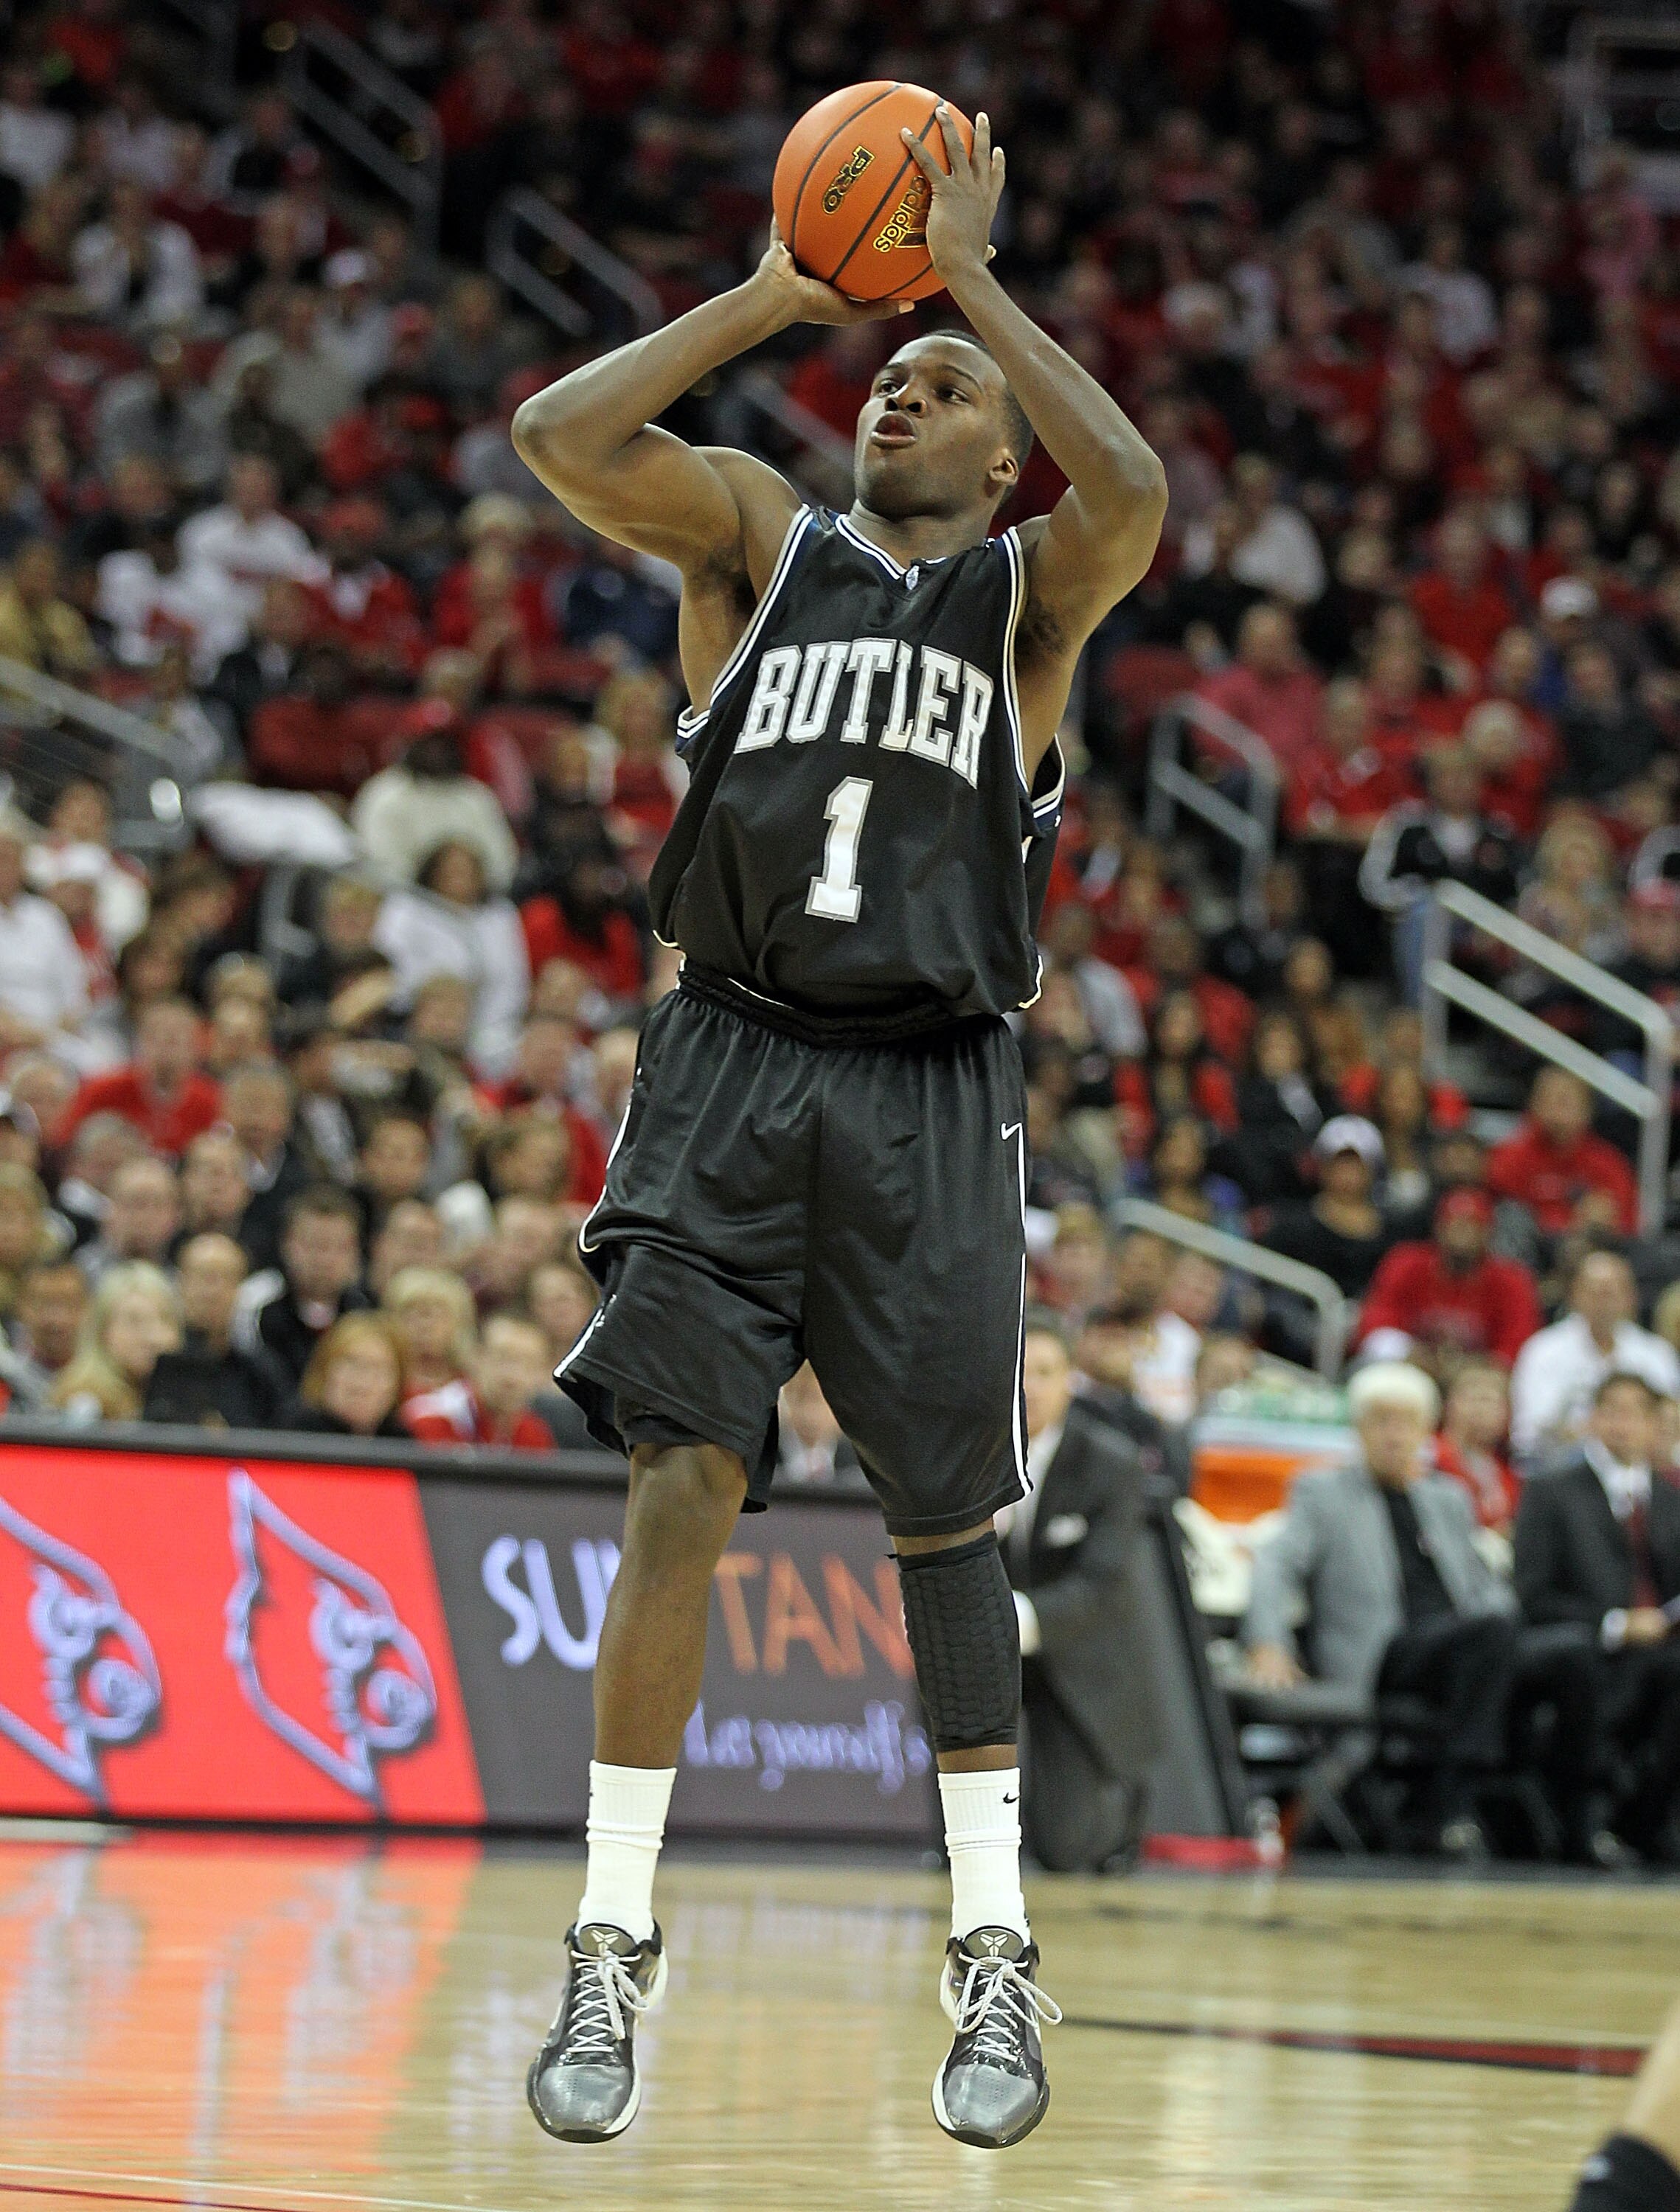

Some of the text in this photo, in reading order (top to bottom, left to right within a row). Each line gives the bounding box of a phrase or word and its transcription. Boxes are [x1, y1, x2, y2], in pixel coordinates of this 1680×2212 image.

[822, 145, 875, 214] PRO
[734, 637, 993, 790] BUTLER
[805, 776, 873, 922] 1
[482, 1534, 916, 1679] SU TAN
